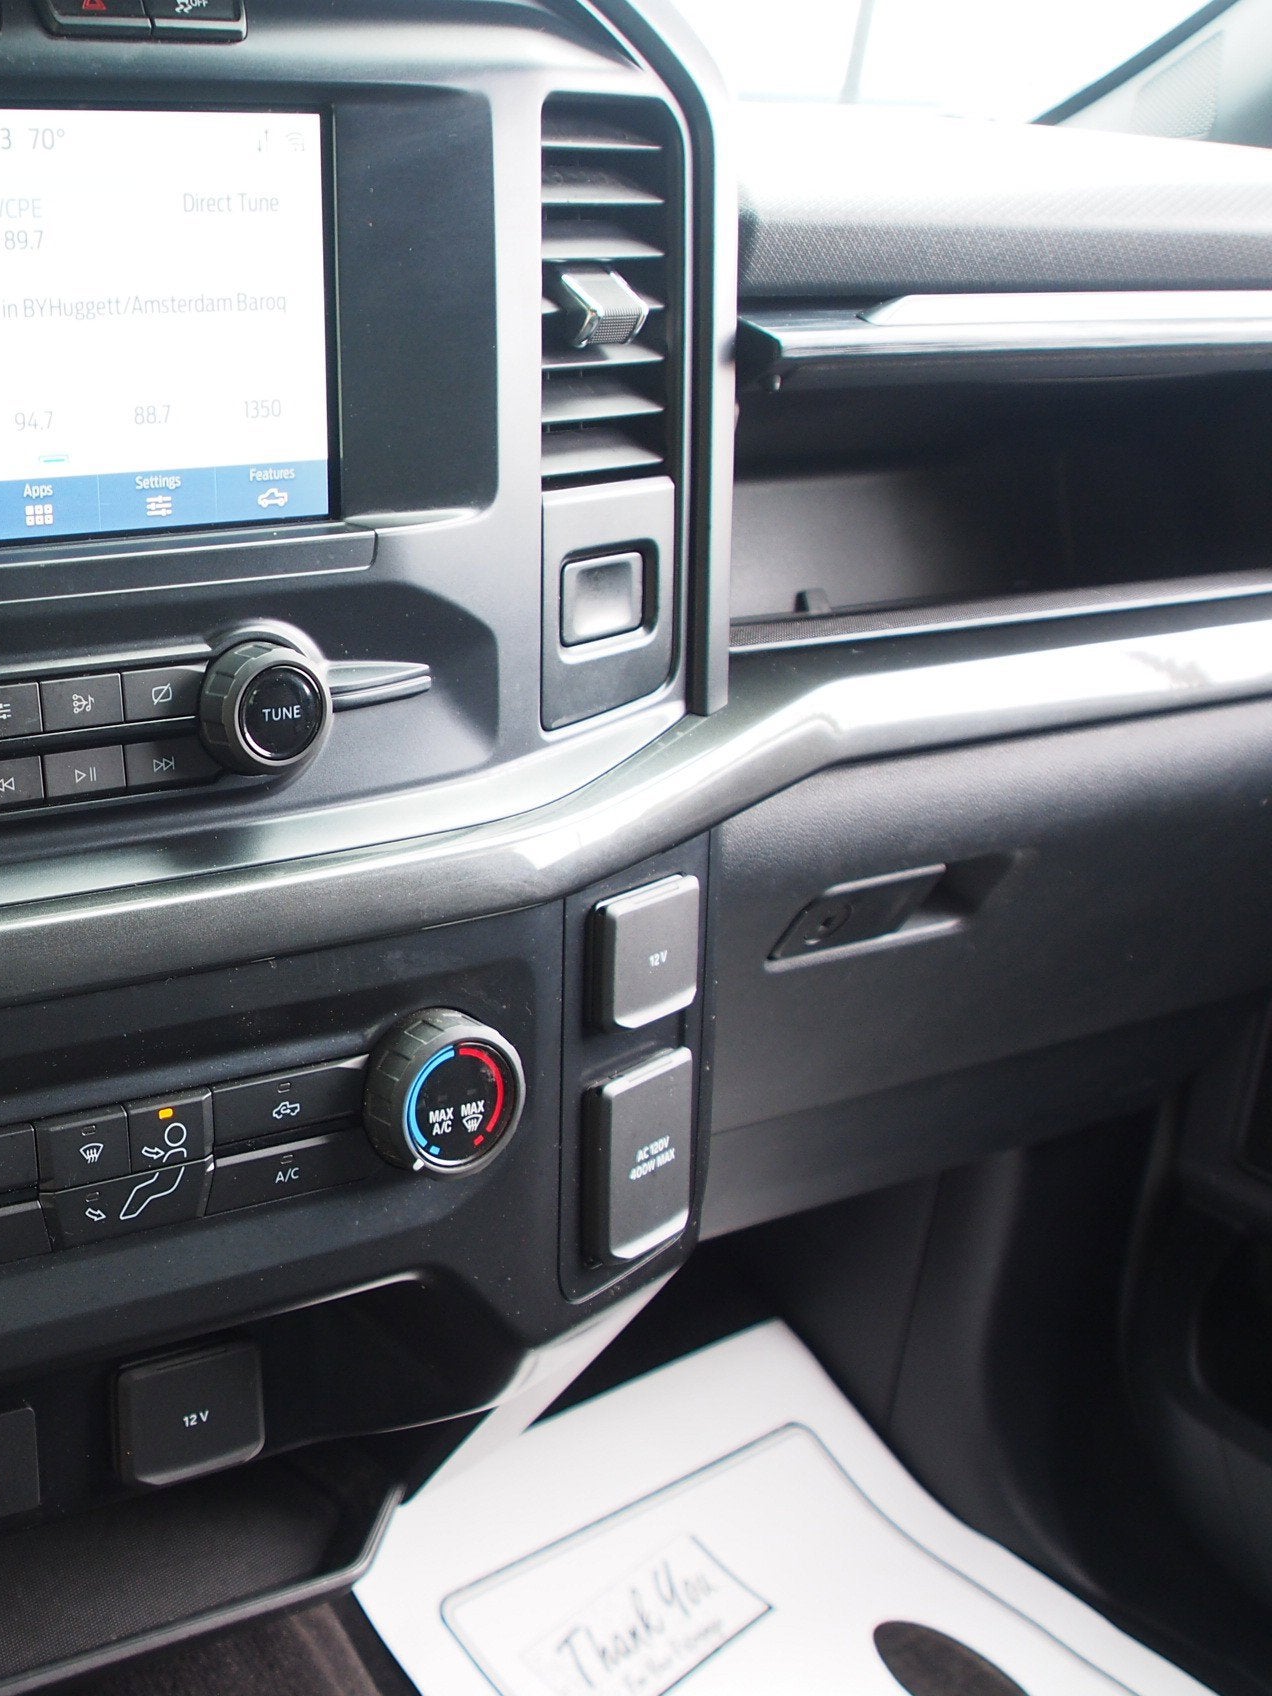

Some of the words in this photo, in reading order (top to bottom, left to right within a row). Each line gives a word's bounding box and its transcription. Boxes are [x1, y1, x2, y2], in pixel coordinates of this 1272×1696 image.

[29, 128, 65, 150] 70°
[183, 193, 231, 212] Direct
[238, 193, 279, 212] Tune
[5, 230, 43, 250] 89.7
[2, 299, 18, 319] in
[135, 405, 170, 424] 88.7
[245, 399, 281, 418] 1350
[15, 411, 52, 431] 94.7
[135, 474, 182, 490] Settings
[249, 467, 296, 482] Features
[23, 483, 53, 499] Apps
[262, 705, 301, 721] TUNE
[429, 1107, 454, 1124] MAX
[461, 1100, 485, 1117] MAX
[432, 1120, 452, 1136] A/C
[656, 1148, 675, 1167] MAX
[276, 1167, 299, 1183] A/C
[555, 1586, 666, 1690] Thank
[652, 1558, 718, 1619] You
